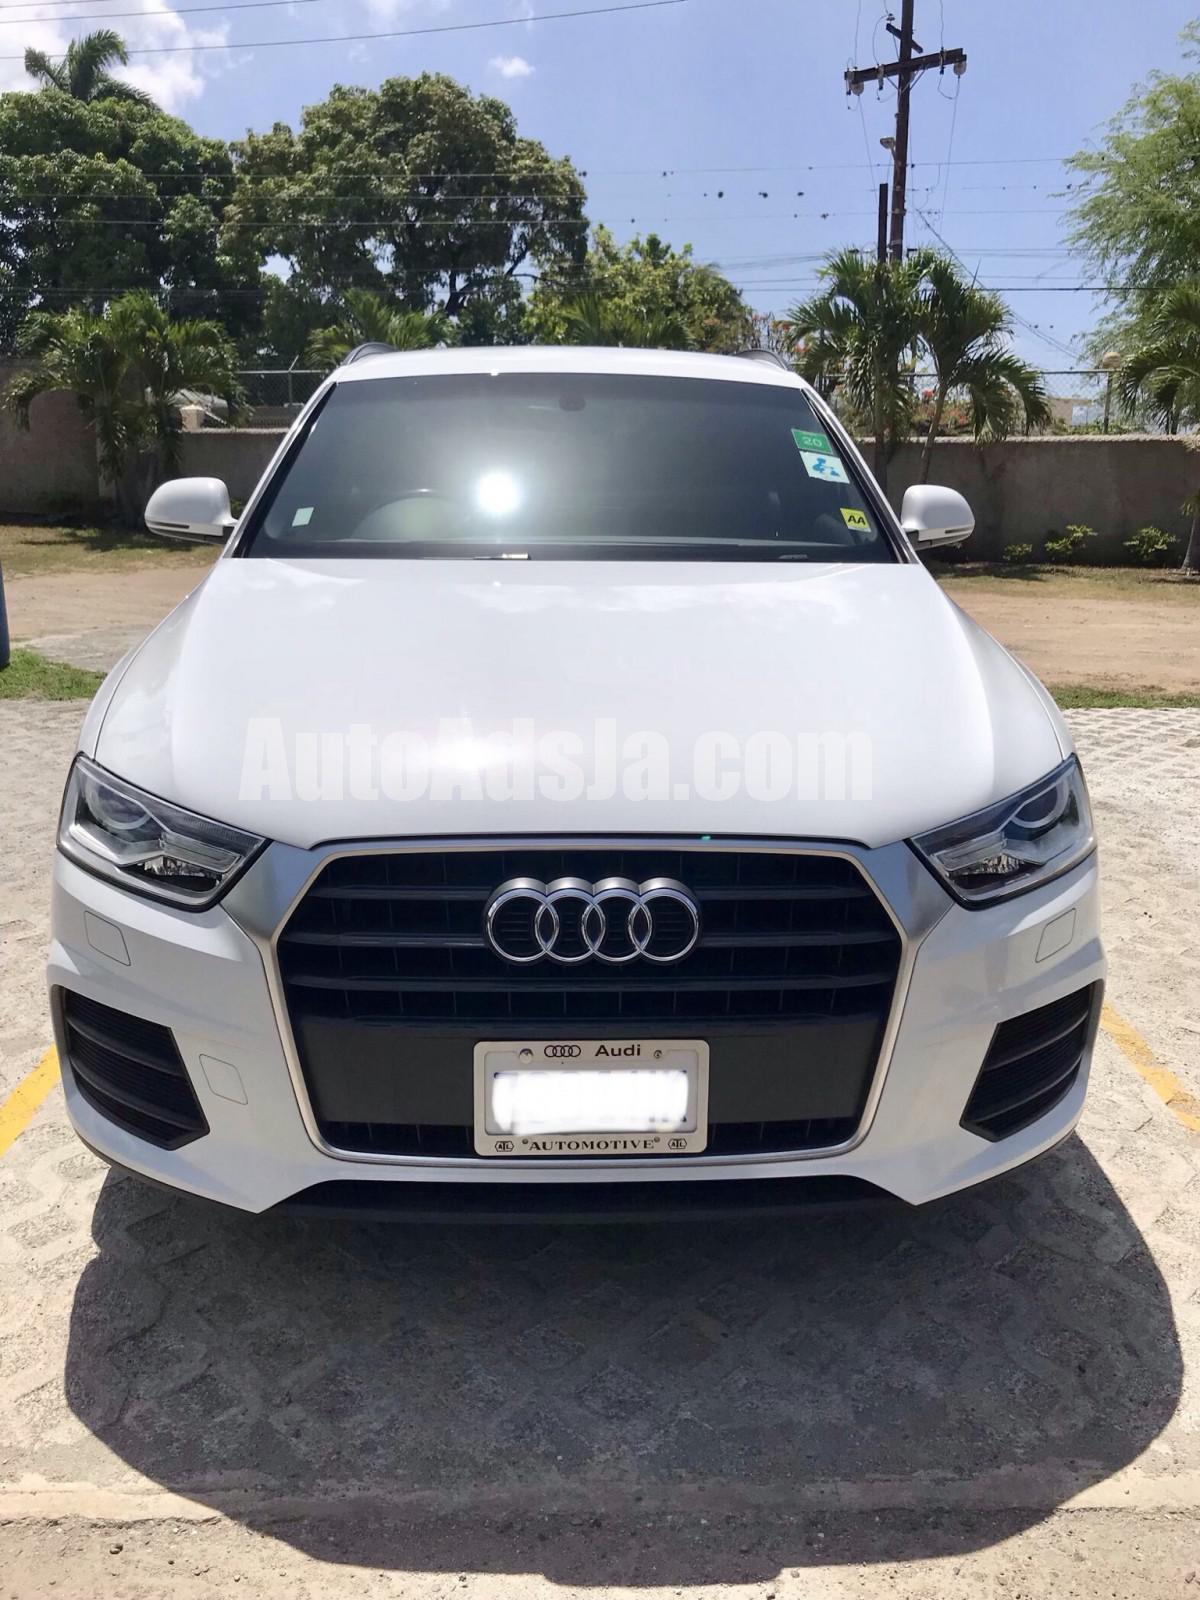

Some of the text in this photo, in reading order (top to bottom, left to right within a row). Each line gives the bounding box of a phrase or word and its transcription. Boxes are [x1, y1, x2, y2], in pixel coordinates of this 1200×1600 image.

[848, 515, 866, 525] AA
[594, 1044, 641, 1057] Audi
[529, 1139, 655, 1151] AUTOMOTIVE
